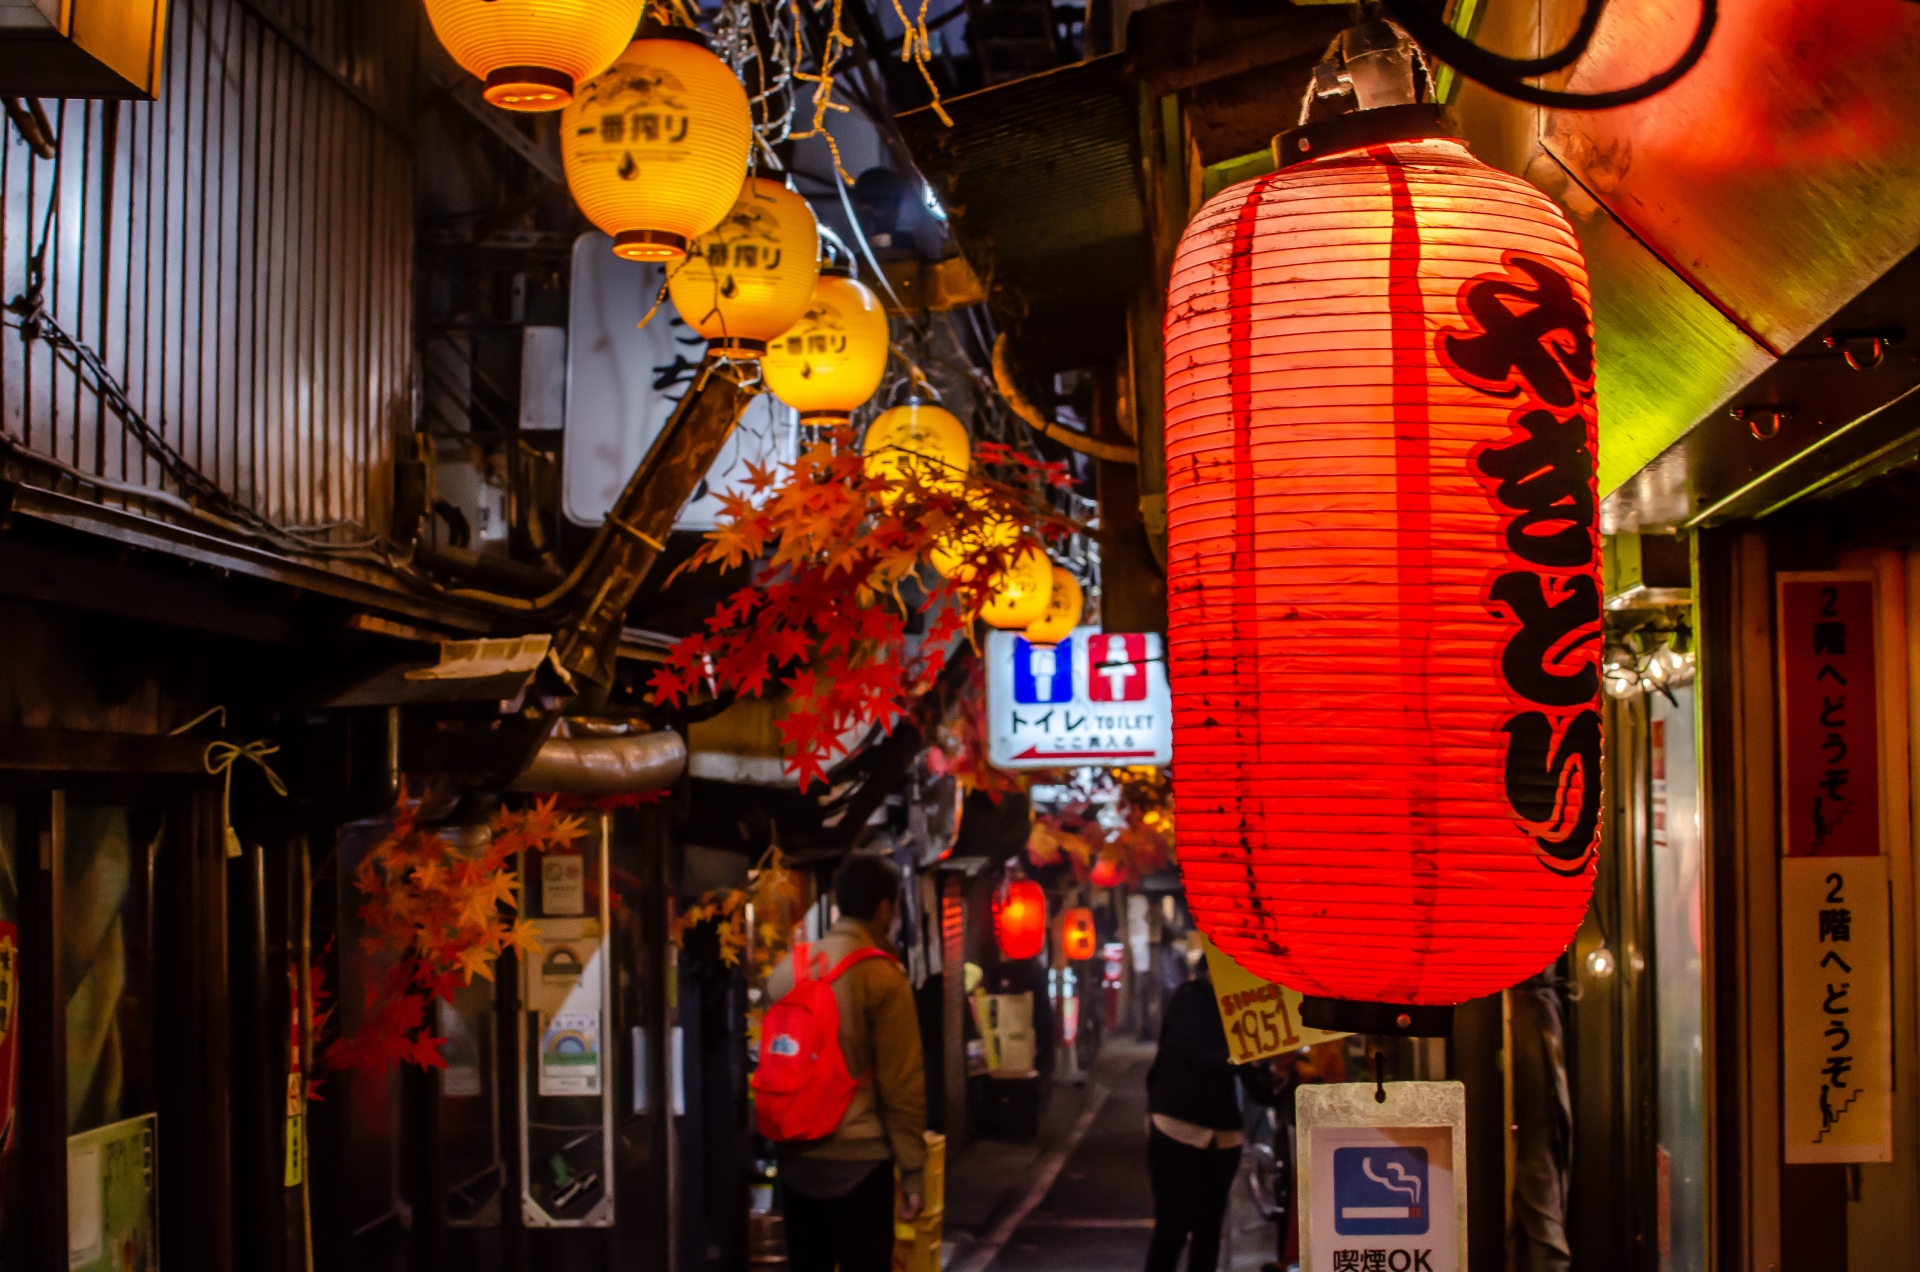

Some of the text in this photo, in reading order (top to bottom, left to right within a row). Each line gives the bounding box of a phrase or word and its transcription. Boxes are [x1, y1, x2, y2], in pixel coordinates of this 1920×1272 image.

[577, 111, 688, 144] 一番搾り
[771, 334, 846, 355] 一番搾り
[1441, 252, 1602, 876] やきとり
[1813, 586, 1850, 801] 2階へどうぞ
[1012, 710, 1155, 734] トイレ TOILET
[1221, 982, 1283, 1016] SINCE
[1819, 872, 1853, 1089] 2階へどうぞ
[1231, 998, 1300, 1060] 1951
